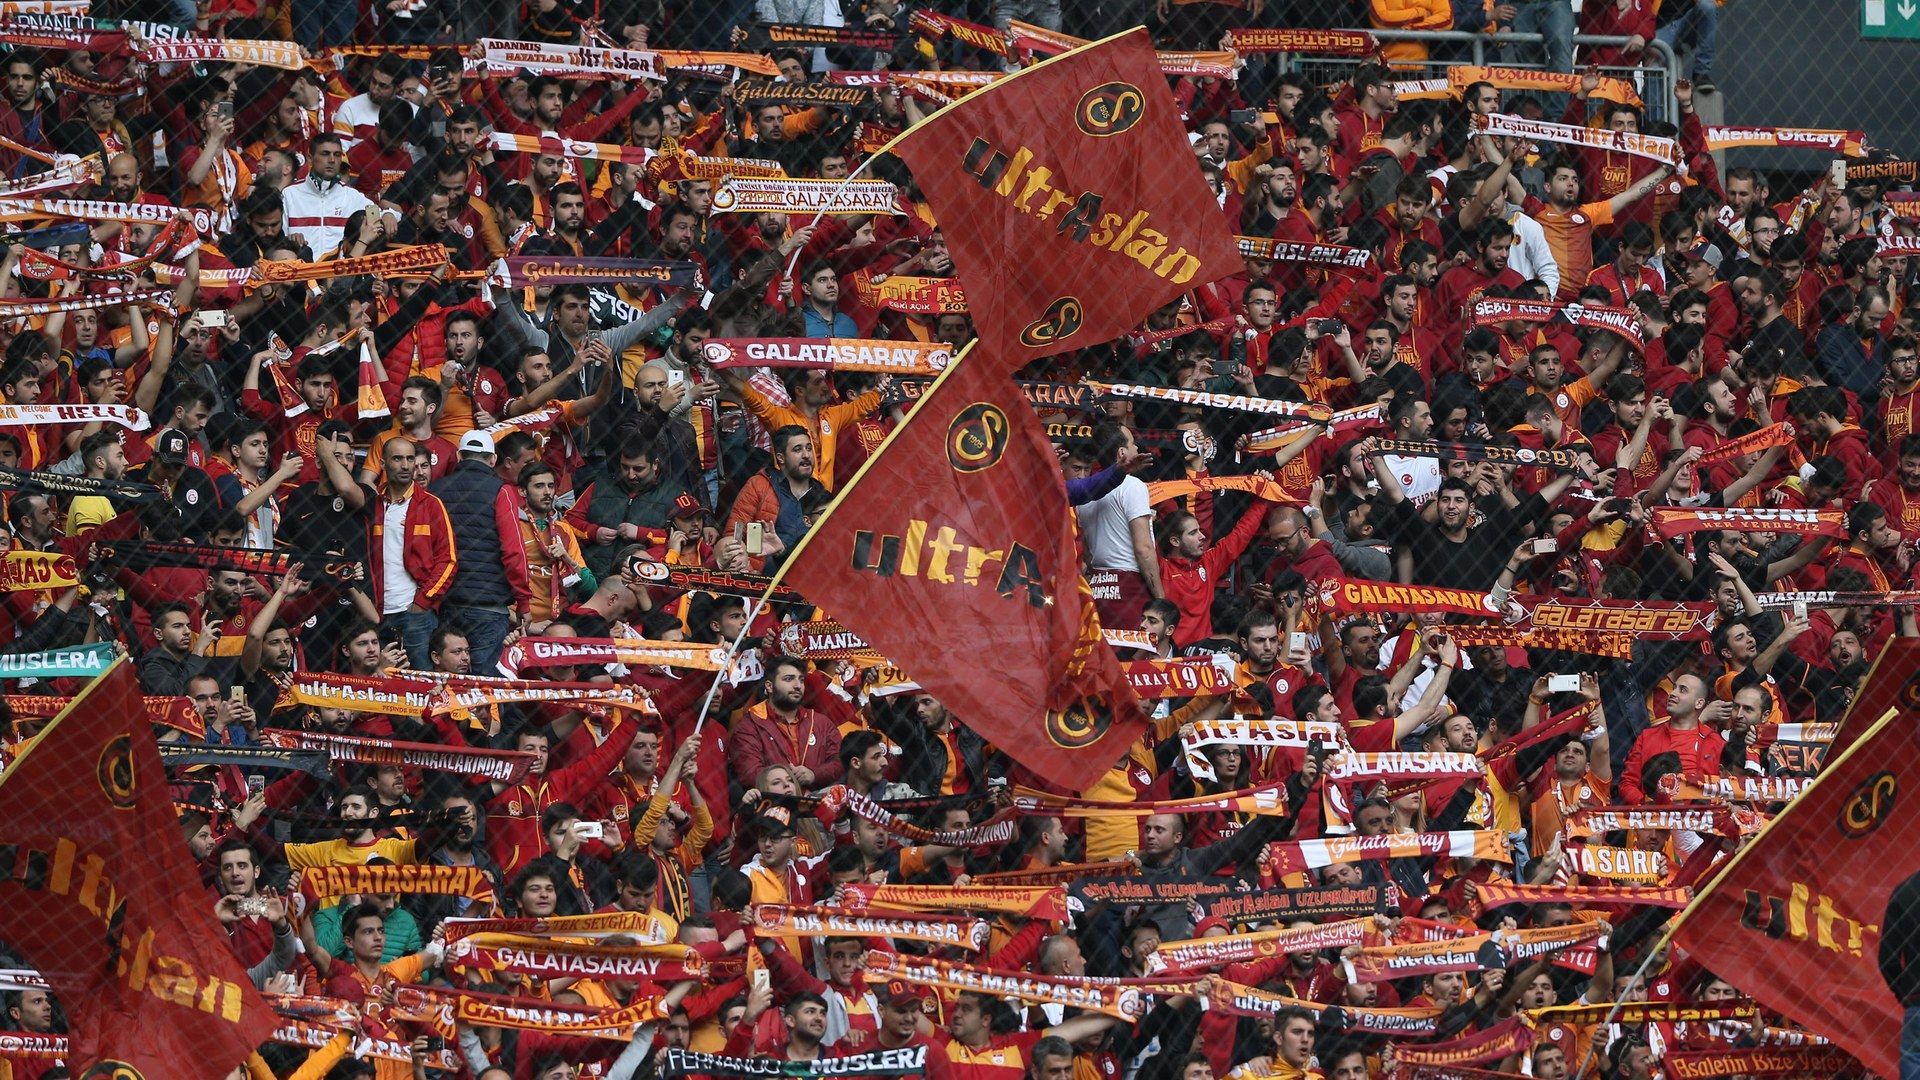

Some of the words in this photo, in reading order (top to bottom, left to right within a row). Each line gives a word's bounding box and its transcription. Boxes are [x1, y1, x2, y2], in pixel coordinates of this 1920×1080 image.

[488, 41, 541, 54] ADANMIŞ
[569, 48, 649, 72] ultrAslan
[1491, 117, 1569, 138] Peşindeyiz
[1571, 127, 1670, 159] ultrAslan
[1708, 127, 1773, 143] Metin
[1777, 129, 1843, 148] Oktay
[785, 191, 889, 208] GALATASARAY
[963, 136, 1202, 284] ultrAslan
[1273, 243, 1370, 268] ASLANLAR
[884, 286, 965, 303] ultrAs
[746, 343, 919, 368] GALATASARAY
[57, 405, 124, 420] HELL
[1110, 384, 1303, 417] GALATASARAY
[1345, 583, 1482, 611] GALATASARAY
[808, 633, 868, 651] MANIS
[1171, 665, 1229, 690] 1905
[299, 680, 399, 704] ultrAslan
[1330, 751, 1479, 778] GALATASARA
[1330, 834, 1446, 859] GalataSaray
[307, 865, 483, 898] GALATASARAY
[1210, 891, 1290, 920] ultrAslan
[1296, 886, 1378, 907] UZUNKÖPRÜ
[552, 920, 581, 932] TEK
[829, 914, 961, 942] KEMALPAŞA
[497, 947, 662, 977] GALATASARAY
[1172, 938, 1253, 961] ultrAslan
[1388, 951, 1477, 969] ultrAslan
[888, 982, 901, 994] 10
[947, 967, 1103, 1008] KEMALPAŞA
[668, 1049, 781, 1075] FERNANDO
[809, 1046, 927, 1075] MUSLERA
[1672, 1055, 1749, 1078] Asaletin
[1750, 1054, 1794, 1072] Bize
